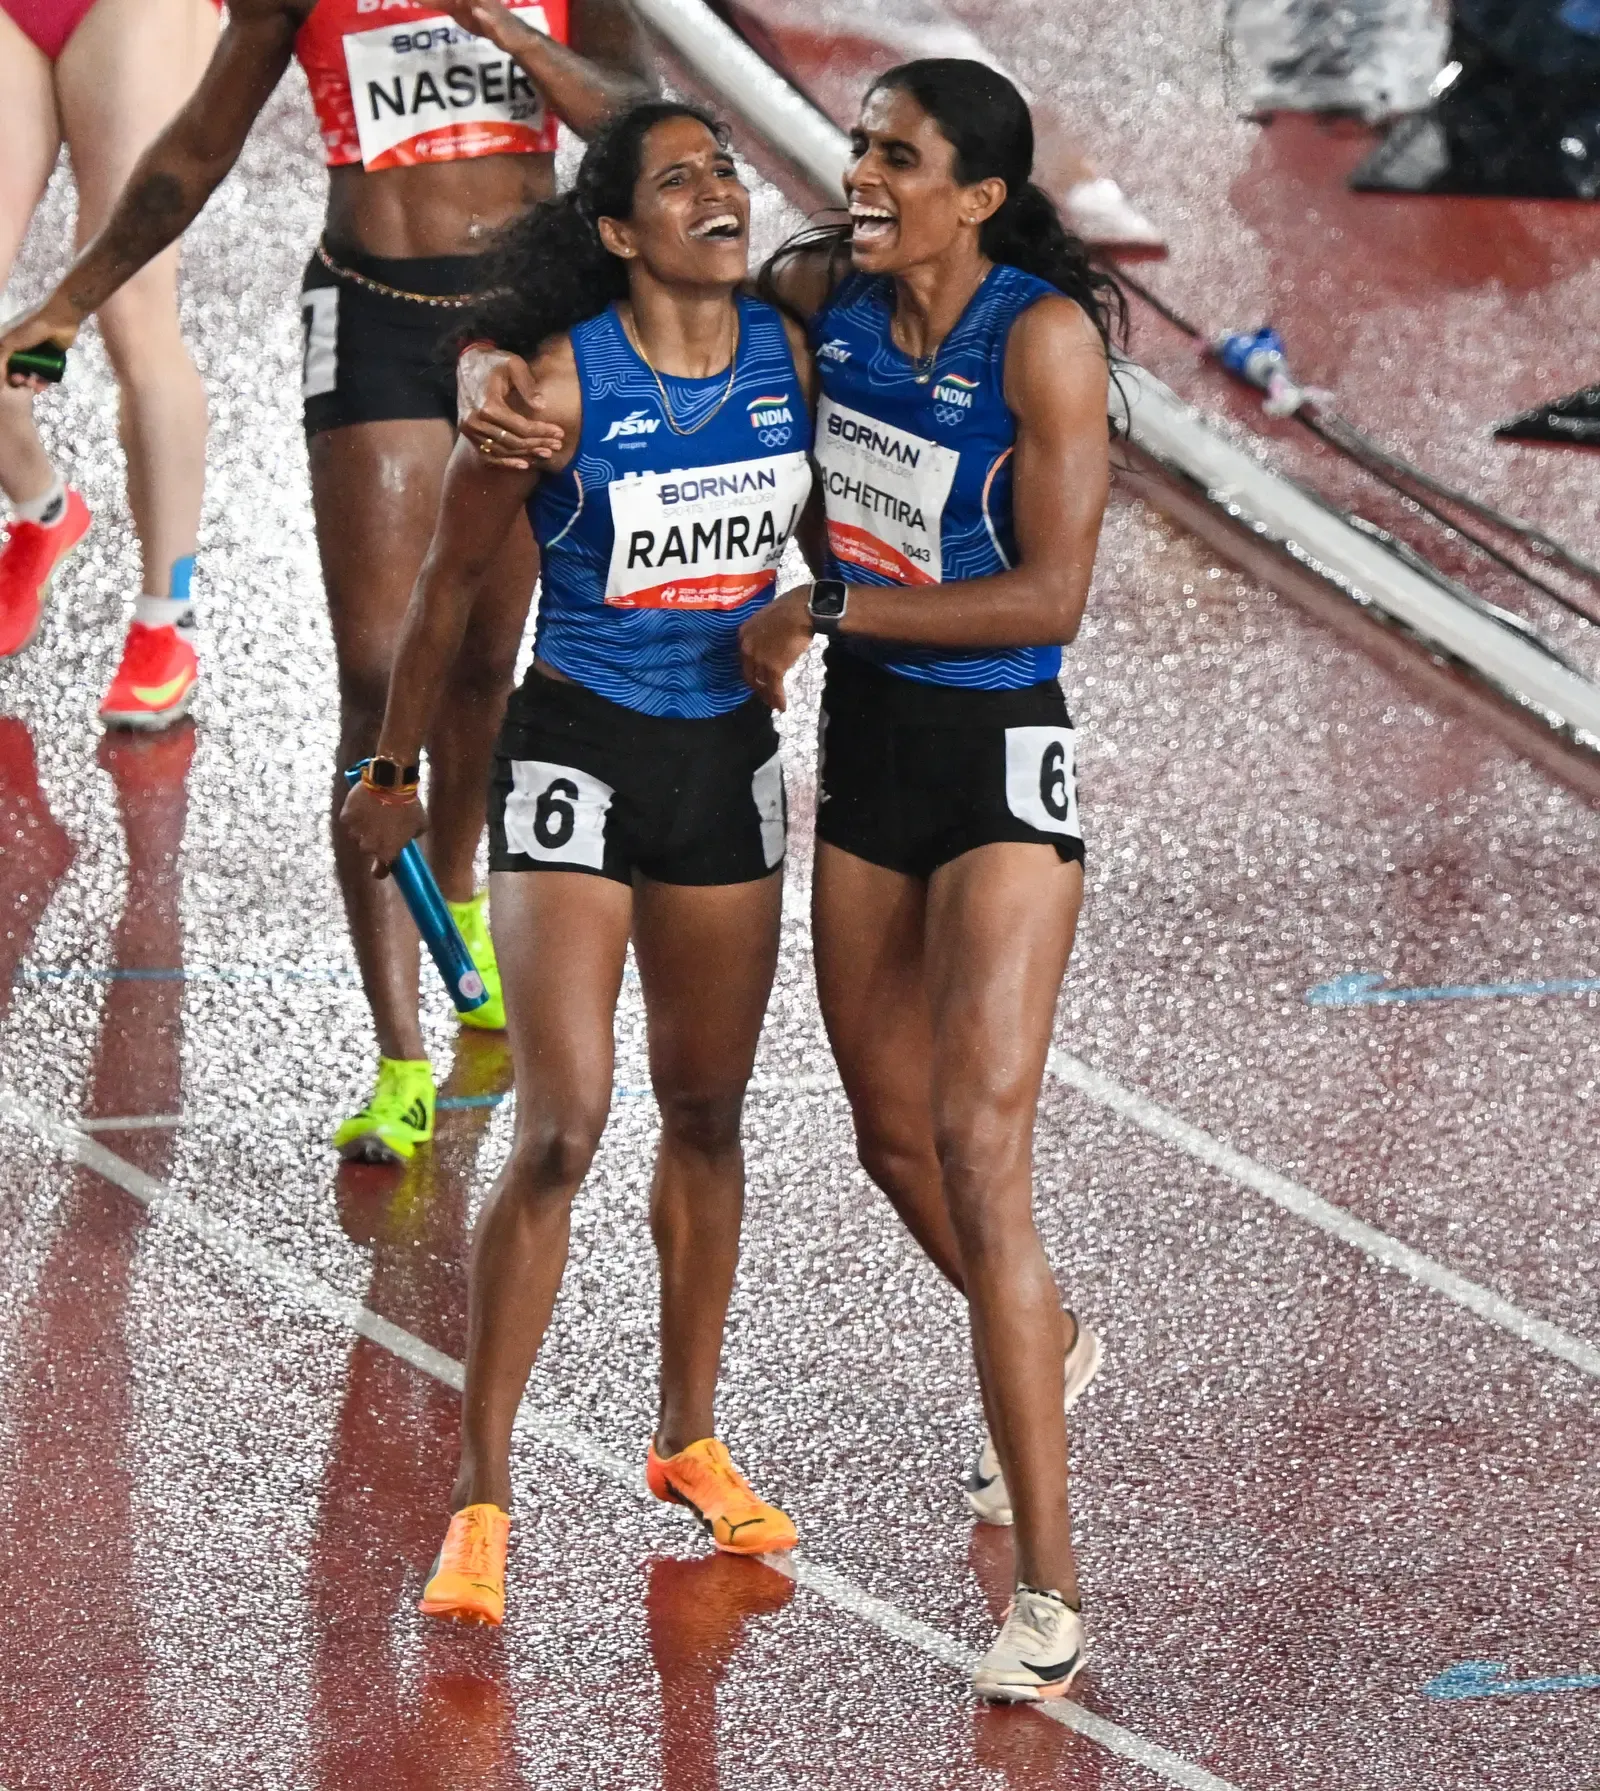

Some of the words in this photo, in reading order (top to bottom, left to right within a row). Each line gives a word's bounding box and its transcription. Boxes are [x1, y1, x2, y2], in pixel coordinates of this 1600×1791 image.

[367, 59, 536, 120] NASER
[751, 408, 794, 429] INDIA
[932, 385, 973, 409] INDIA
[600, 417, 661, 442] JSW
[827, 413, 920, 469] BORNAN
[657, 468, 777, 505] BORNAN
[627, 503, 798, 569] RAMRAJ
[902, 542, 932, 562] 1043
[1040, 741, 1075, 821] 6
[533, 778, 579, 849] 6
